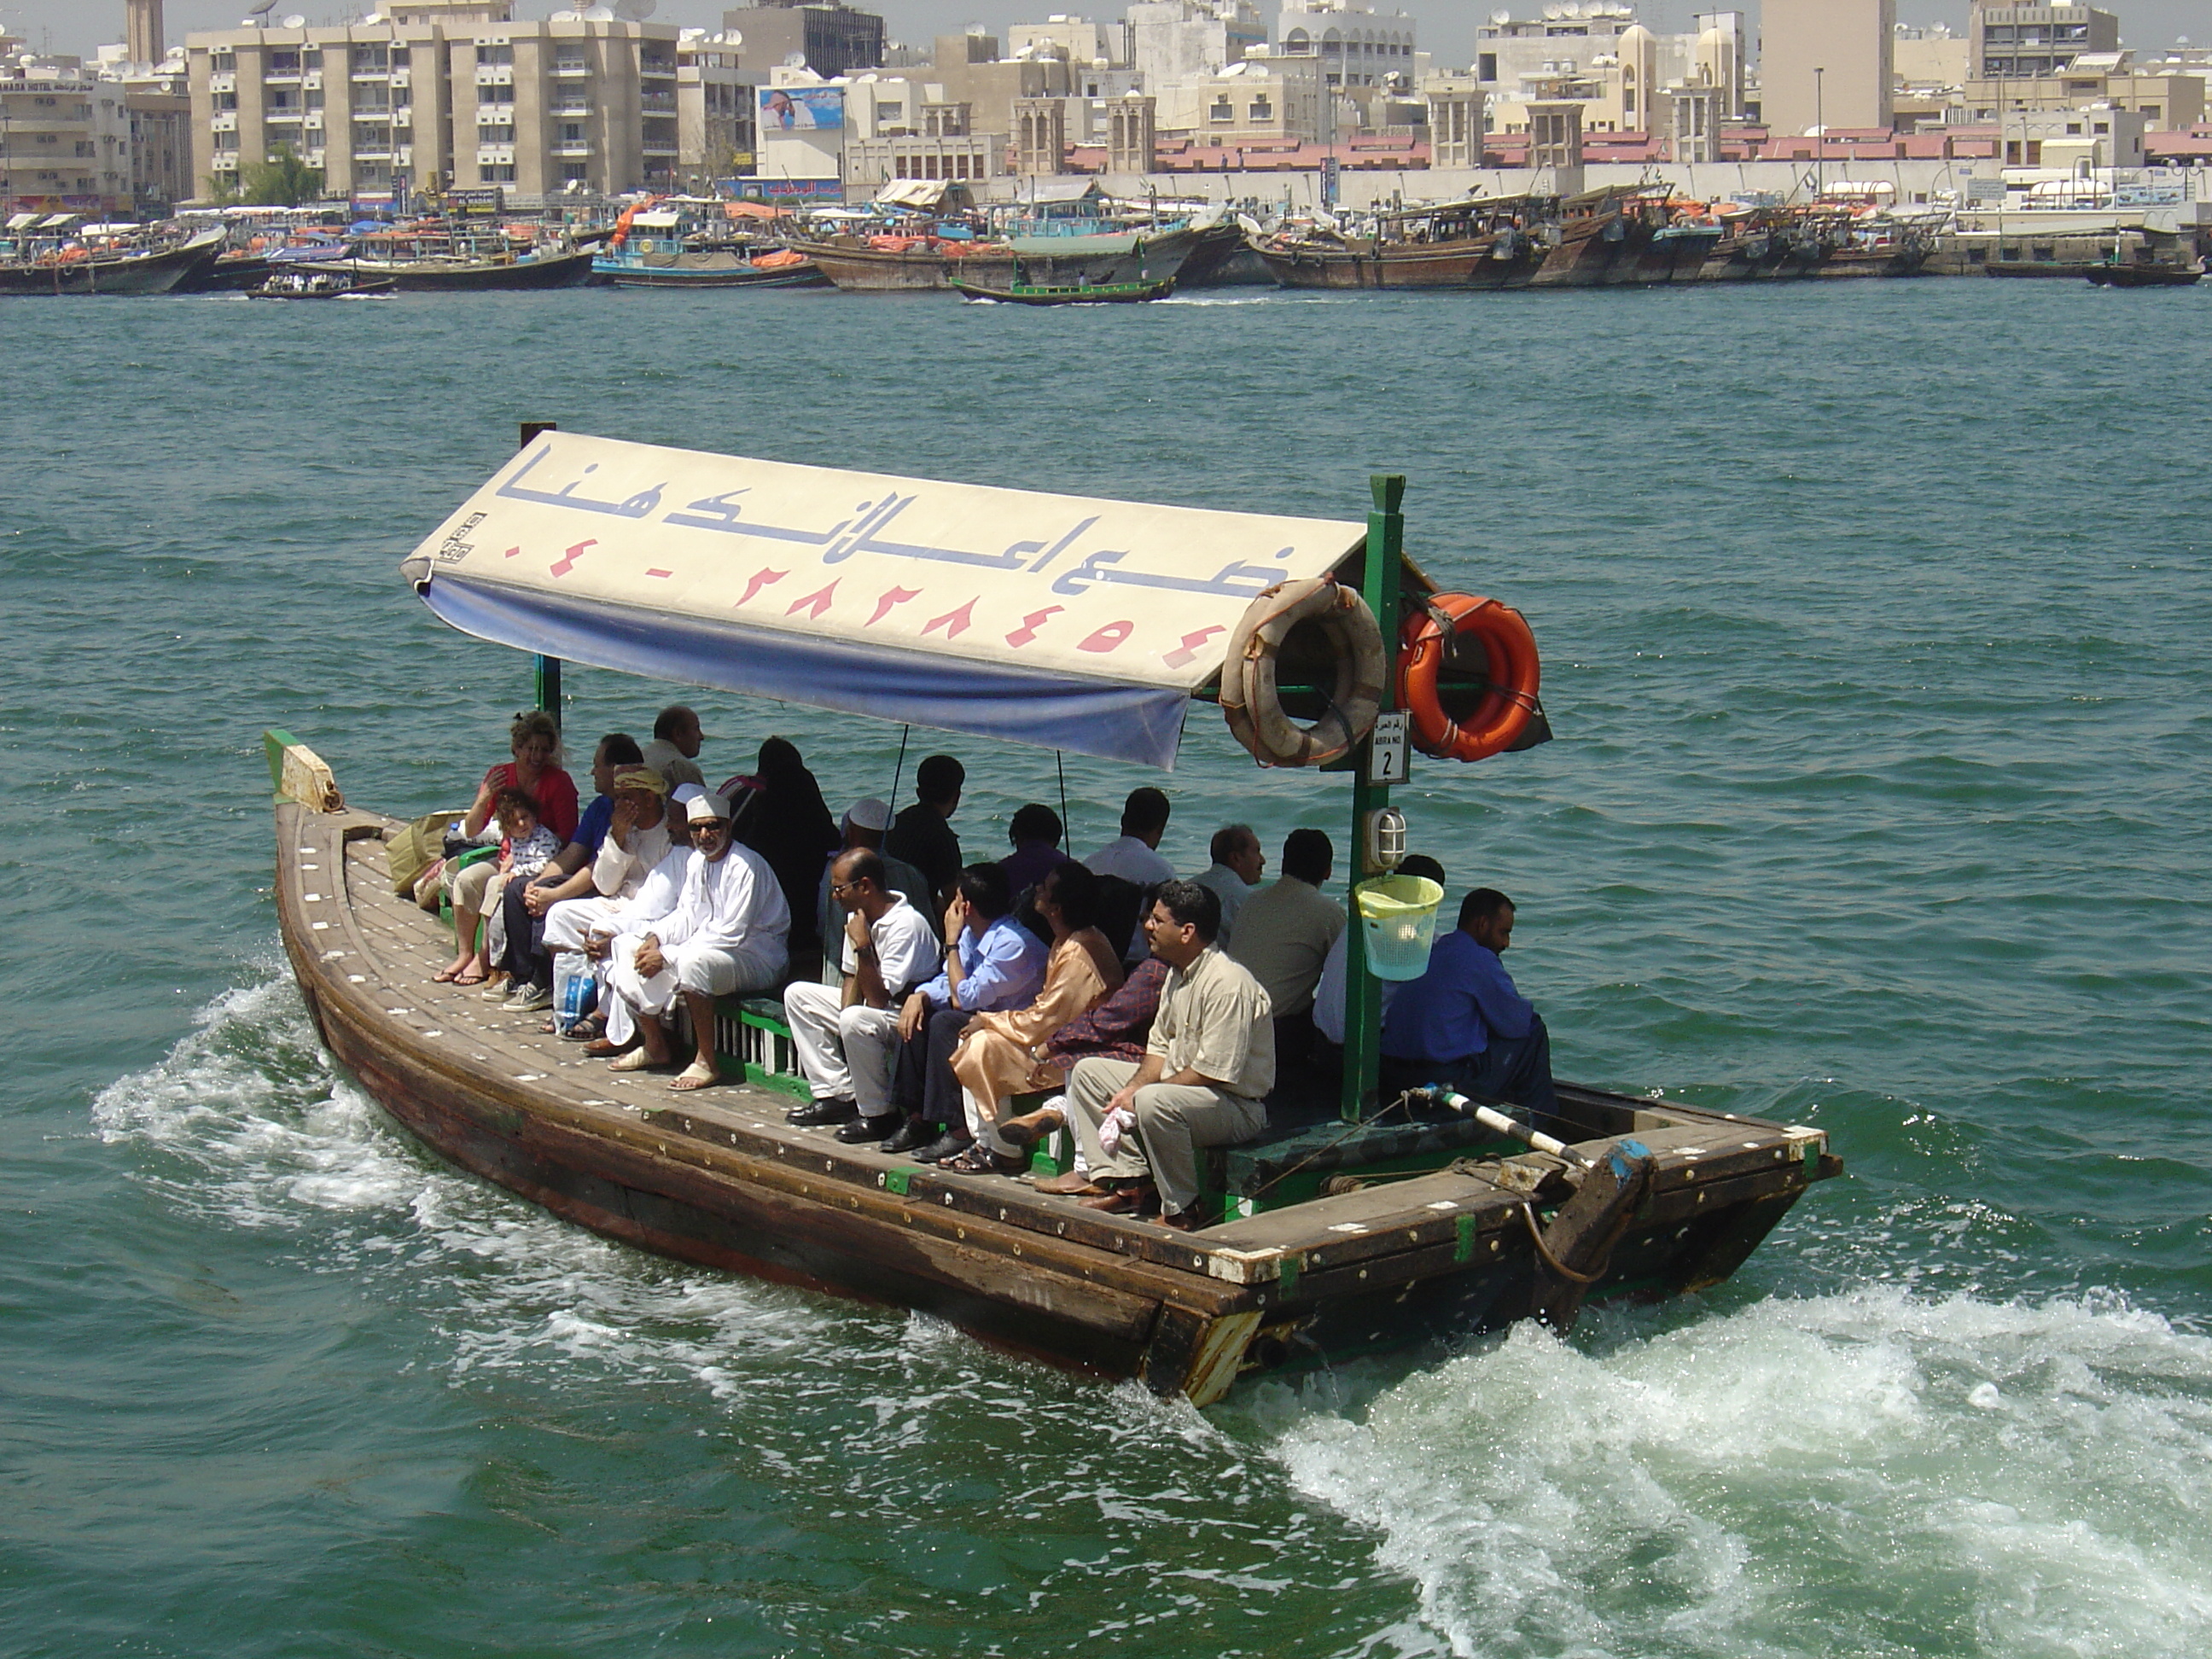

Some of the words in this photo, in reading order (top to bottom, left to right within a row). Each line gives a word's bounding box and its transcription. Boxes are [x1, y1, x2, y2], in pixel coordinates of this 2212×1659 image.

[27, 83, 52, 91] HOTEL
[1375, 736, 1390, 745] ABRA
[1382, 751, 1392, 776] 2
